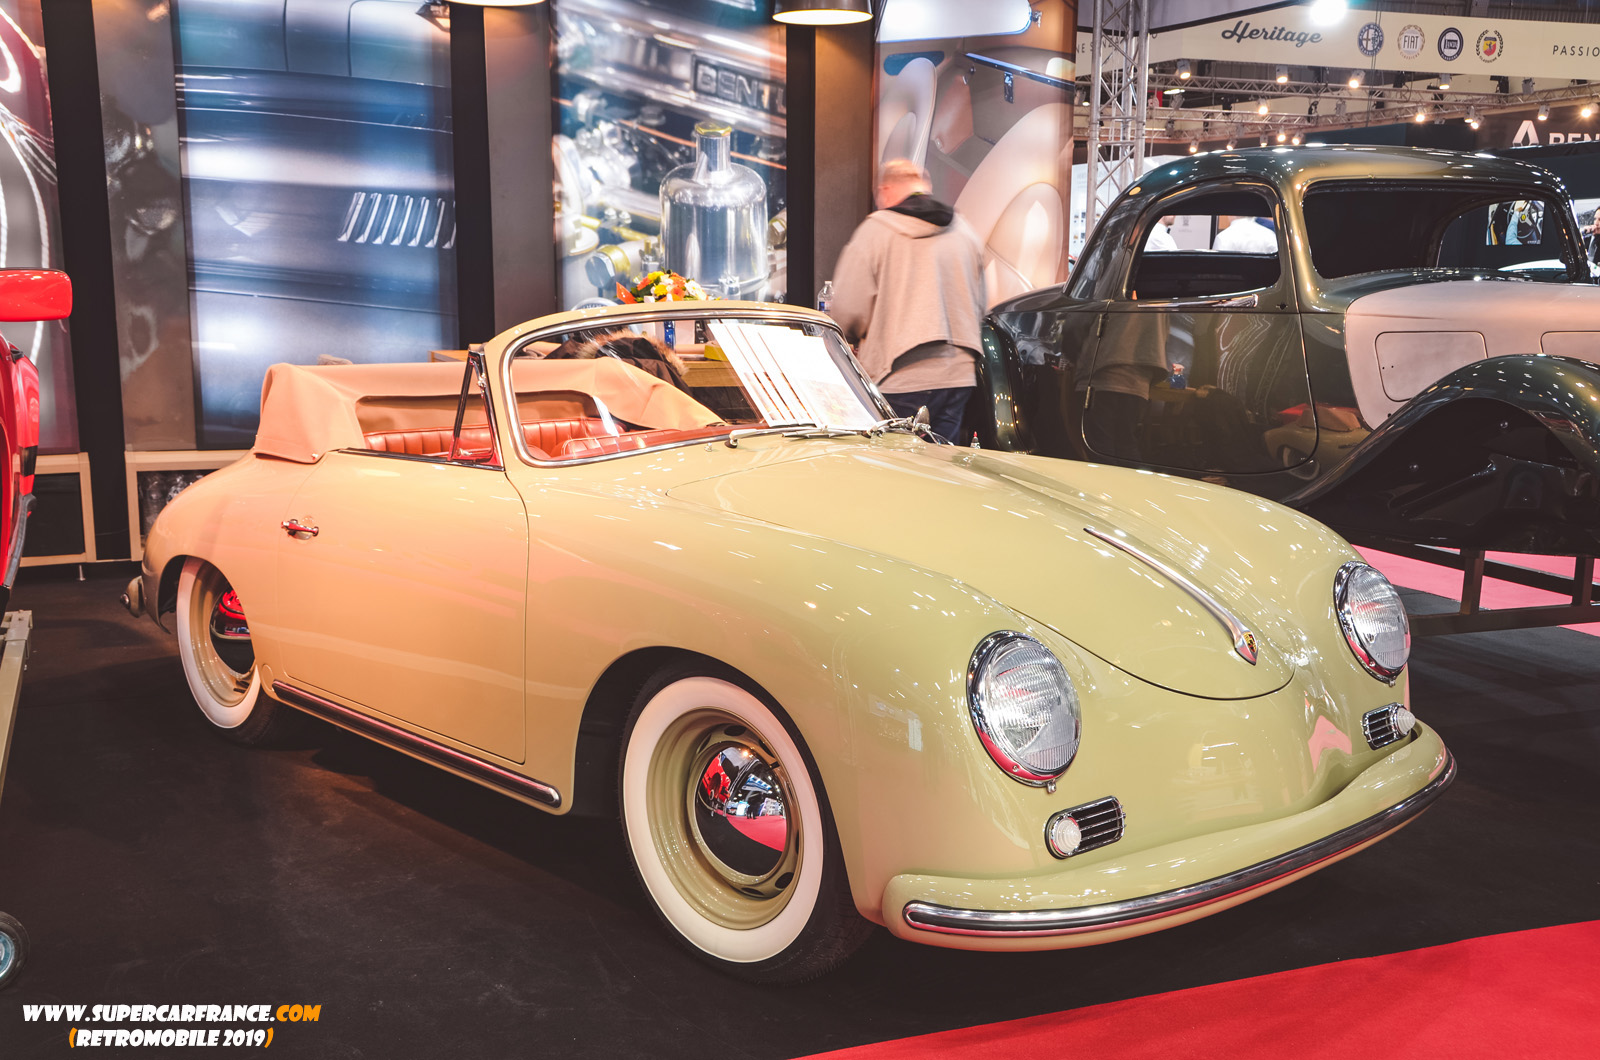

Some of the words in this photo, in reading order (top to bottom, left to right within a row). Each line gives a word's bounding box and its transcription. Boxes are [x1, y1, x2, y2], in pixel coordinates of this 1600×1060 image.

[1221, 20, 1322, 48] Heritage
[1402, 35, 1419, 49] FIAT
[1552, 44, 1600, 58] PASSIO
